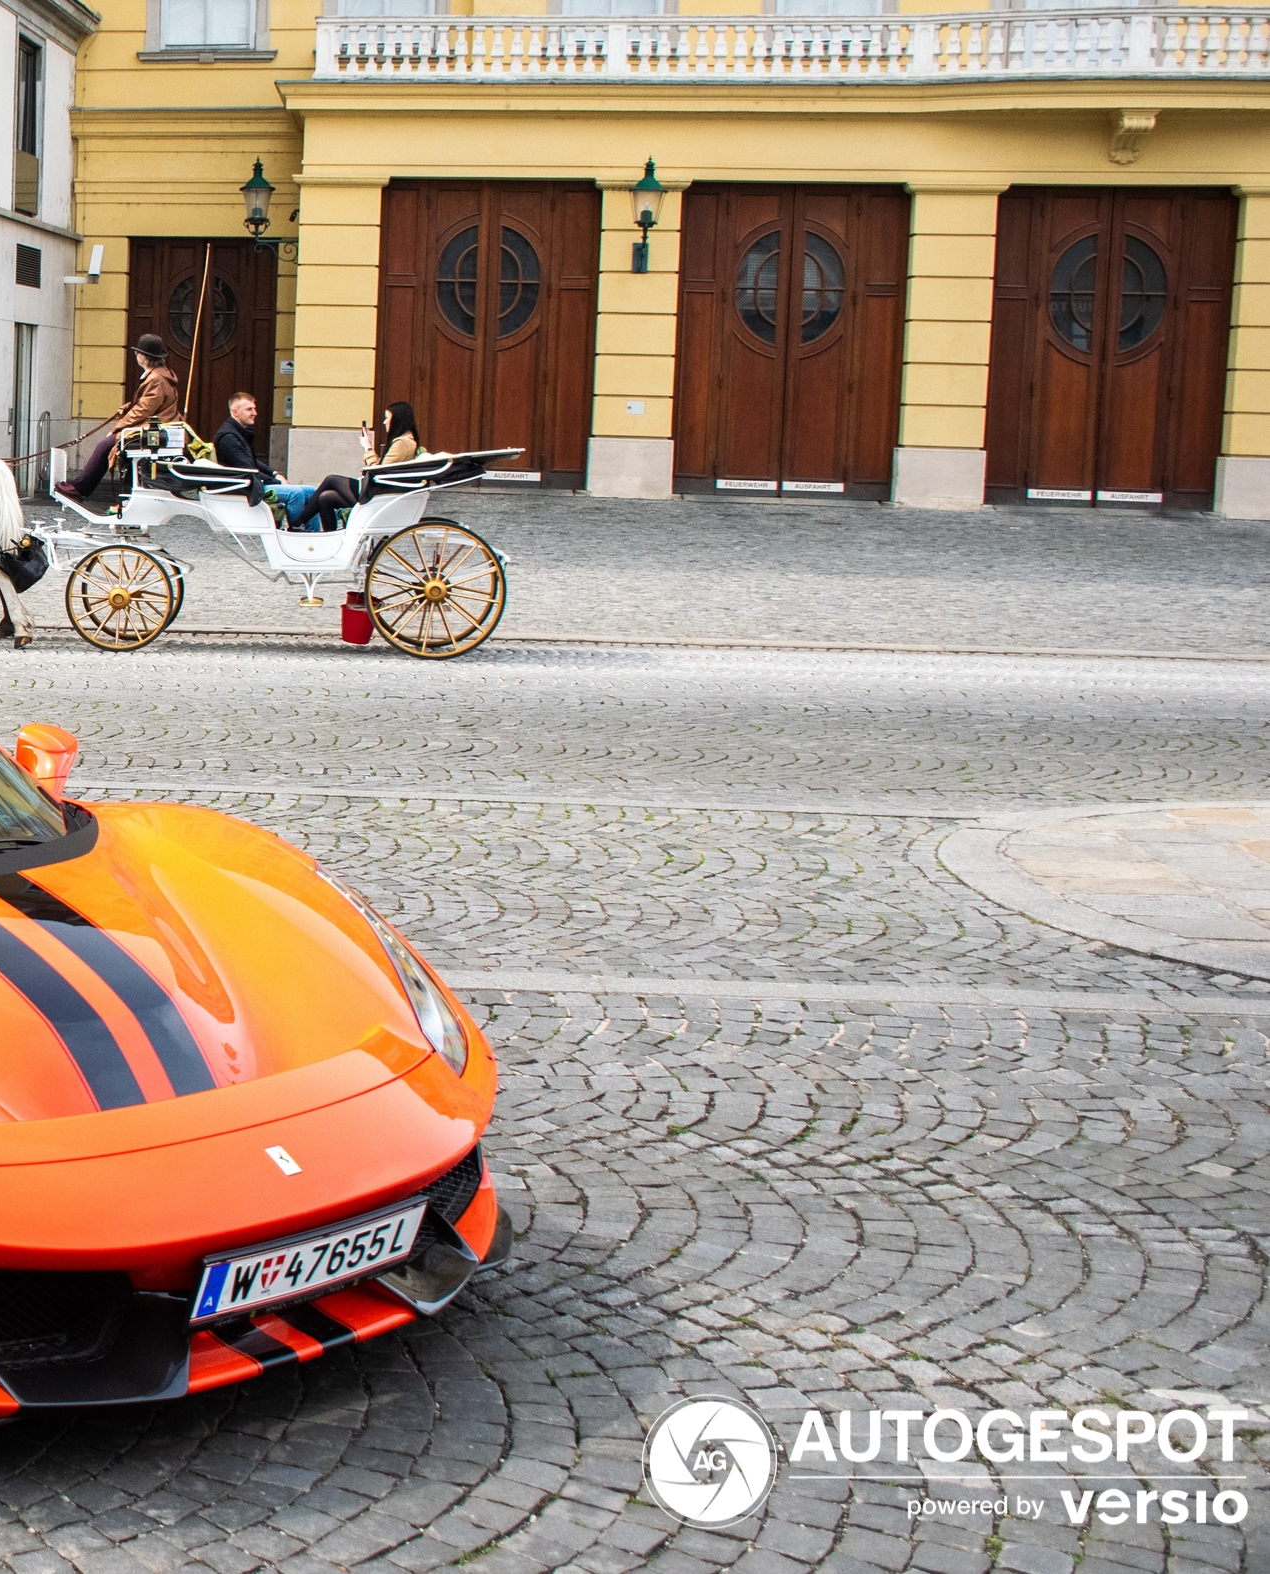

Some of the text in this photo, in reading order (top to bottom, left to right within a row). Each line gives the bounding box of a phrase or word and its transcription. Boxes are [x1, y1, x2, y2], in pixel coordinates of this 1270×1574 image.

[1036, 489, 1082, 498] FEUERWEHR
[230, 1217, 405, 1303] W 47655L
[203, 1296, 213, 1308] A
